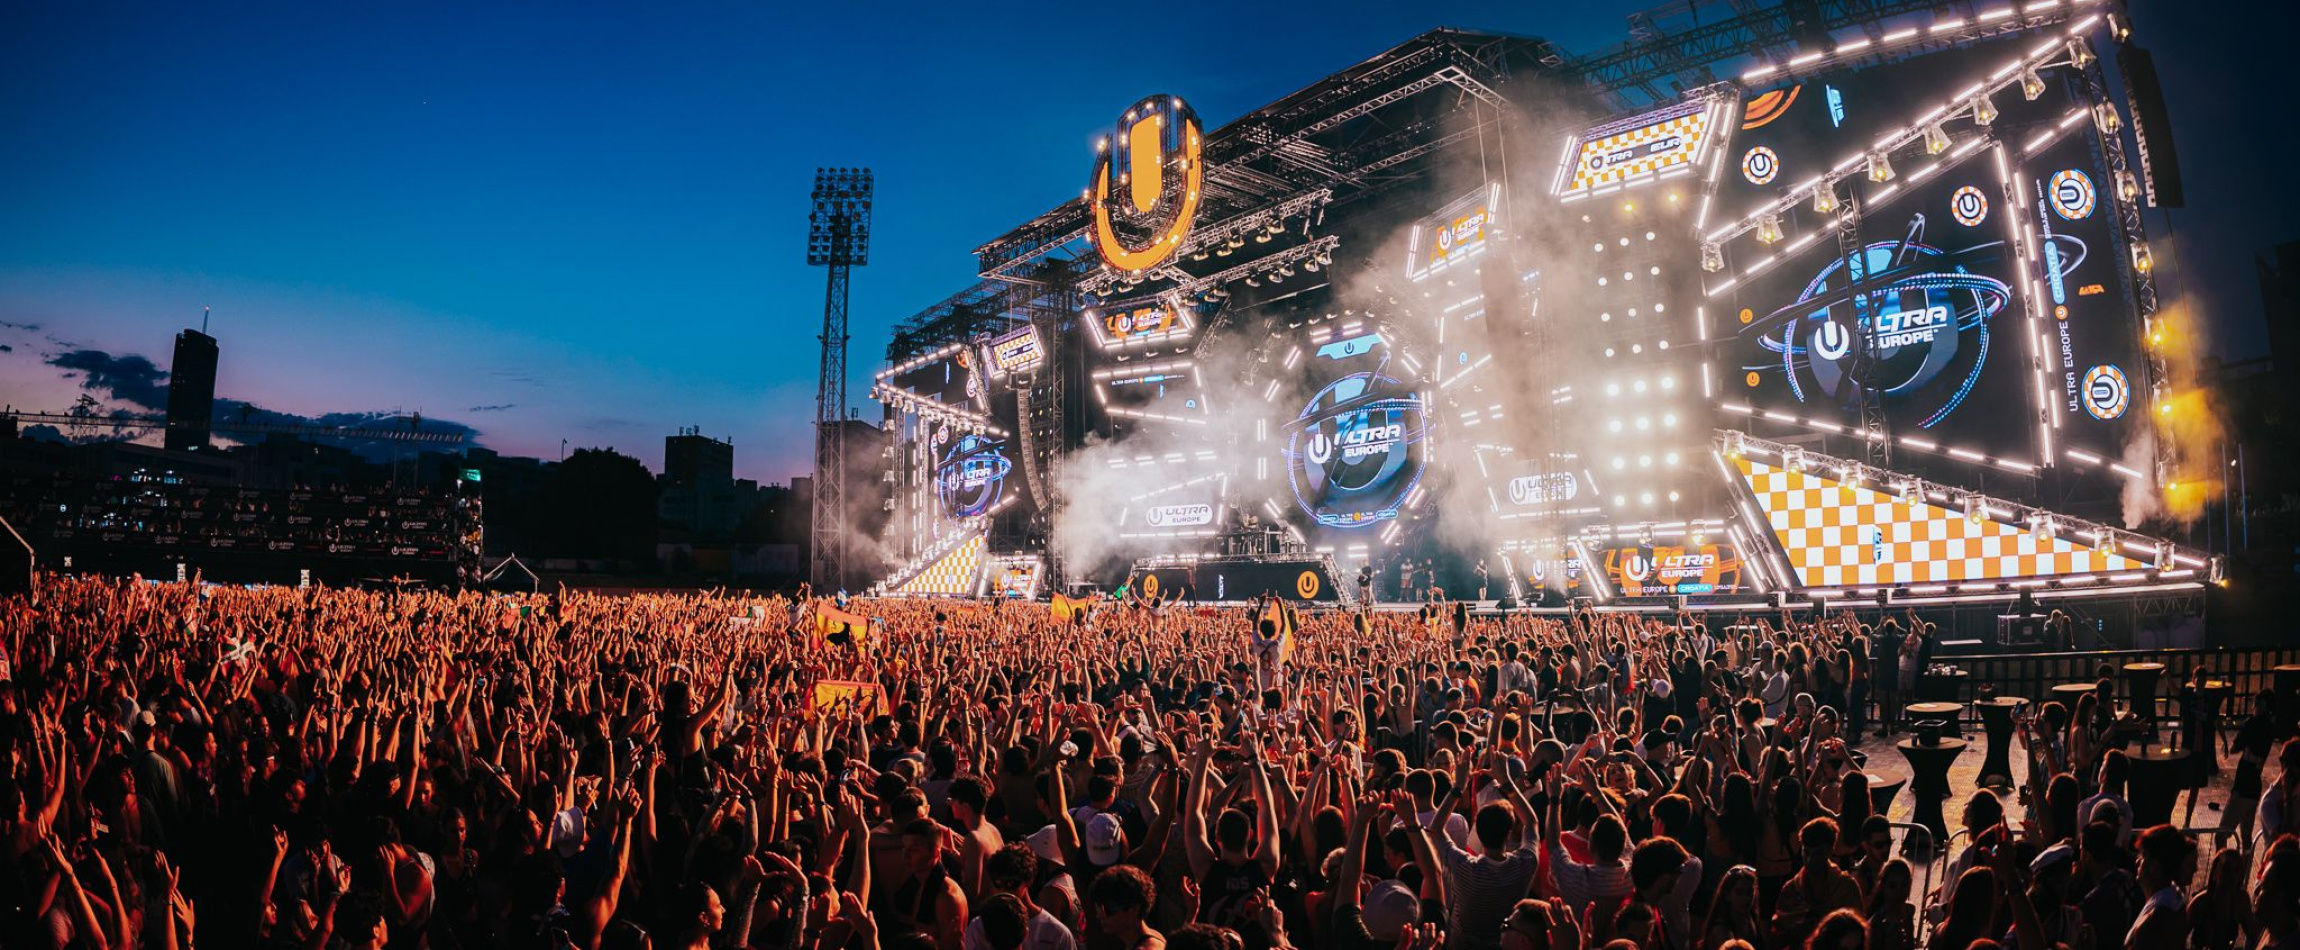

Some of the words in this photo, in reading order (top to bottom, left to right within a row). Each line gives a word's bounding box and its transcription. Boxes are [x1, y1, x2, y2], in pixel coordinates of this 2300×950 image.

[2047, 247, 2062, 298] CROATIA
[2058, 321, 2074, 368] EUROPE
[2066, 372, 2079, 412] ULTRA
[1344, 444, 1390, 458] EUROPE
[1166, 506, 1208, 516] ULTRA
[1660, 569, 1704, 578] EUROPE
[1643, 586, 1668, 594] EUROPE
